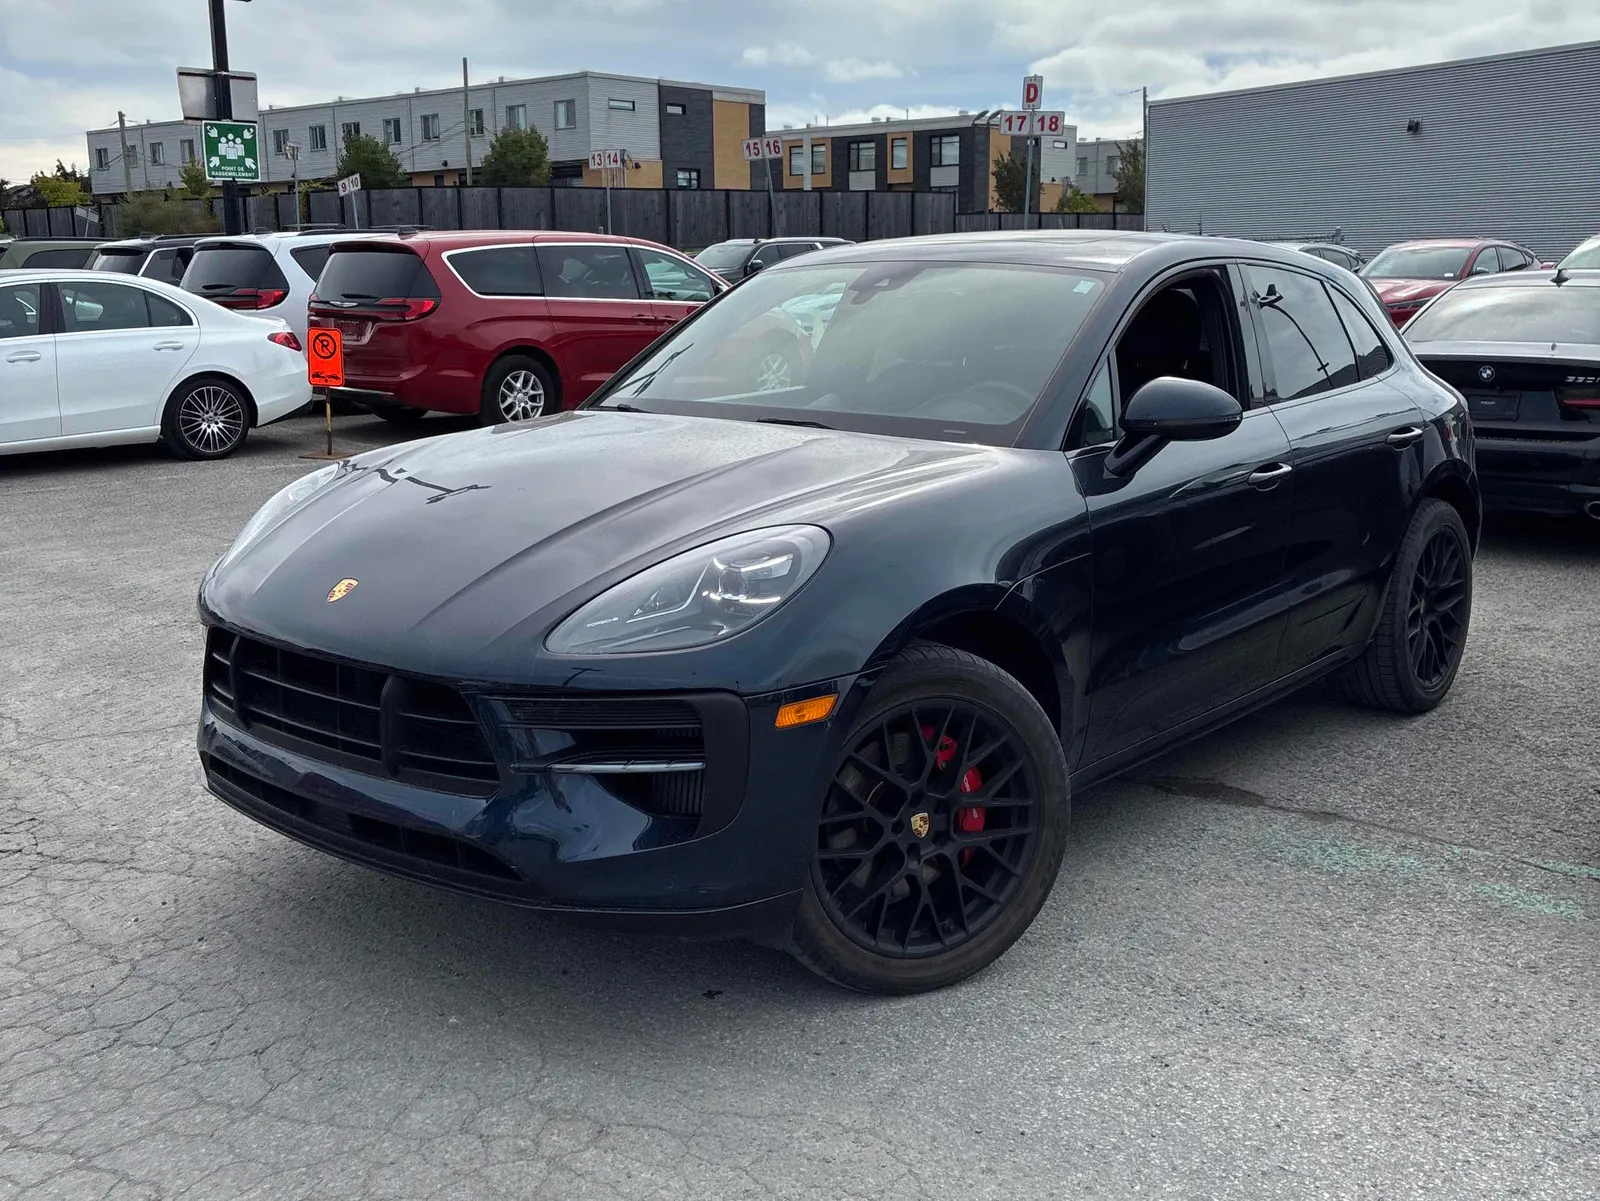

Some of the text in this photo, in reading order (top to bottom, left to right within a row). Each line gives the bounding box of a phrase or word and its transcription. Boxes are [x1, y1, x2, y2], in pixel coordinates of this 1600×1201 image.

[1026, 83, 1038, 103] D
[1005, 115, 1027, 132] 17
[1038, 115, 1059, 132] 18
[745, 142, 760, 157] 15
[766, 139, 780, 155] 16
[591, 152, 603, 167] 13
[606, 152, 619, 166] 14
[350, 176, 359, 188] 10
